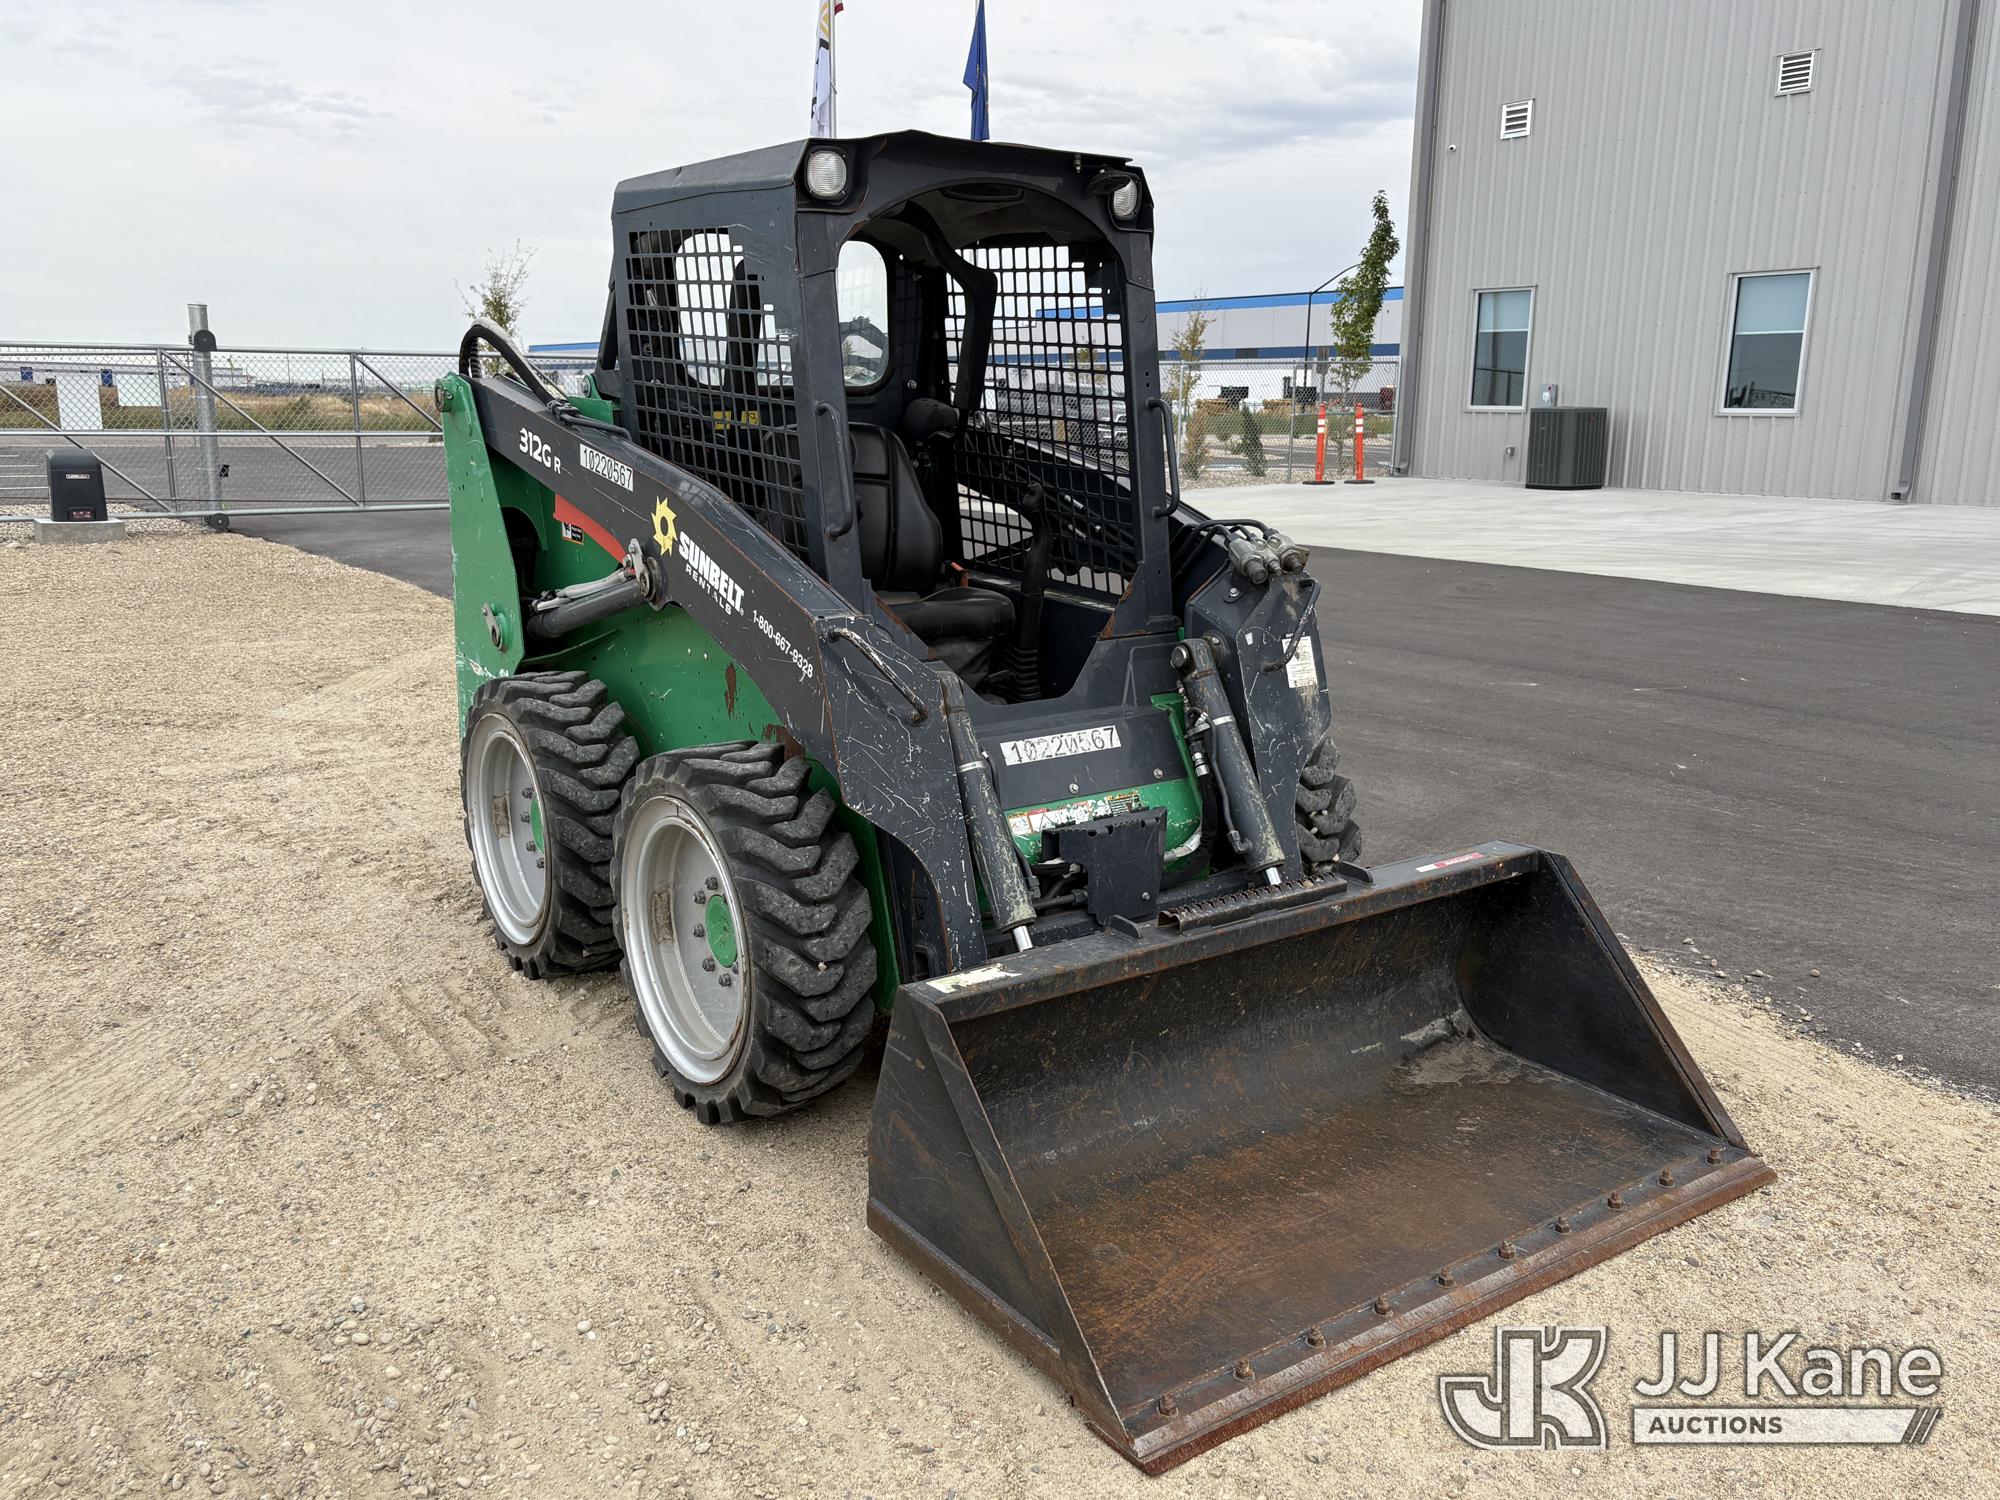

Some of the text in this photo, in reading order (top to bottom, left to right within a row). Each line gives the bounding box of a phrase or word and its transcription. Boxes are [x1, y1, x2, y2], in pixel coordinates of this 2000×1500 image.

[519, 427, 561, 475] 312G R
[583, 446, 633, 490] 10220567
[679, 531, 745, 612] SUNBELT
[685, 563, 732, 615] RENTALS
[753, 610, 813, 679] 1-800-667-9328
[1010, 726, 1115, 763] 10220567
